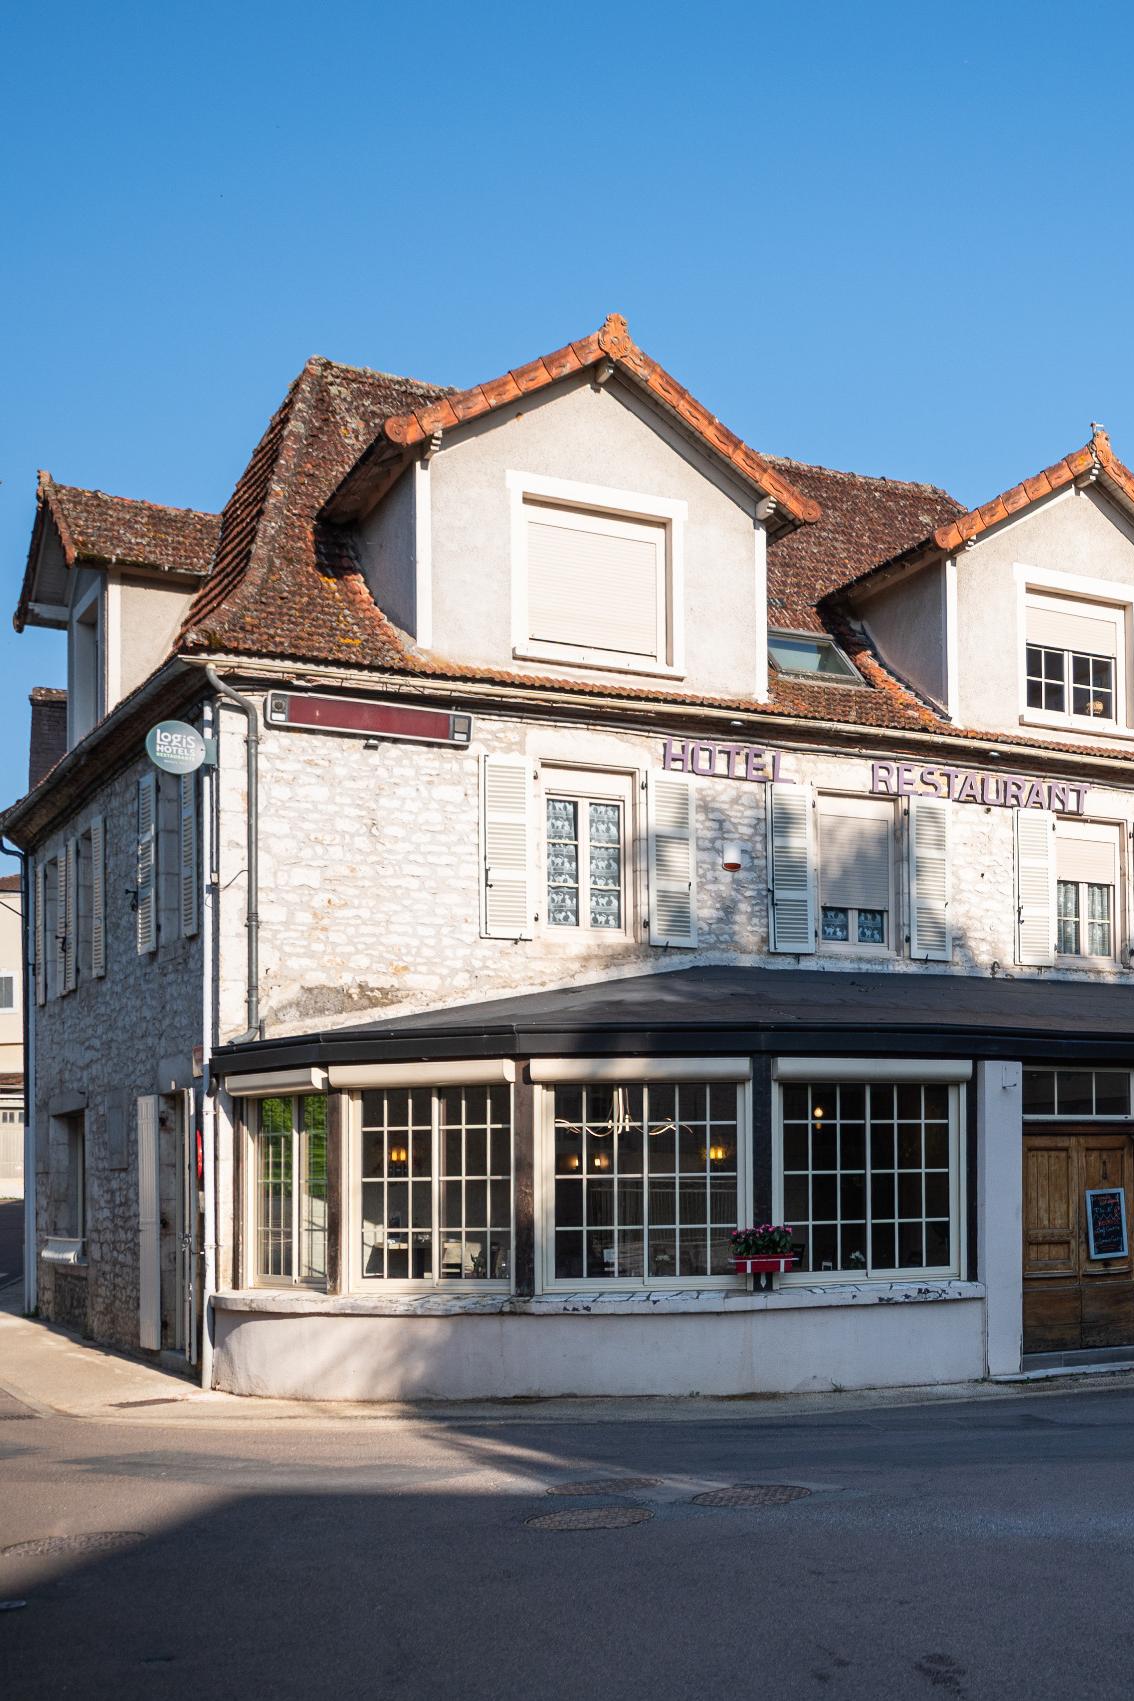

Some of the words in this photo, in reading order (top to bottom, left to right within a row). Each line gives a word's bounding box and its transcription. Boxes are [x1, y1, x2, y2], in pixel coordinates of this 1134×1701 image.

[156, 744, 197, 757] HOTELS
[663, 736, 796, 785] HOTEL
[871, 760, 1093, 815] RESTAURANT
